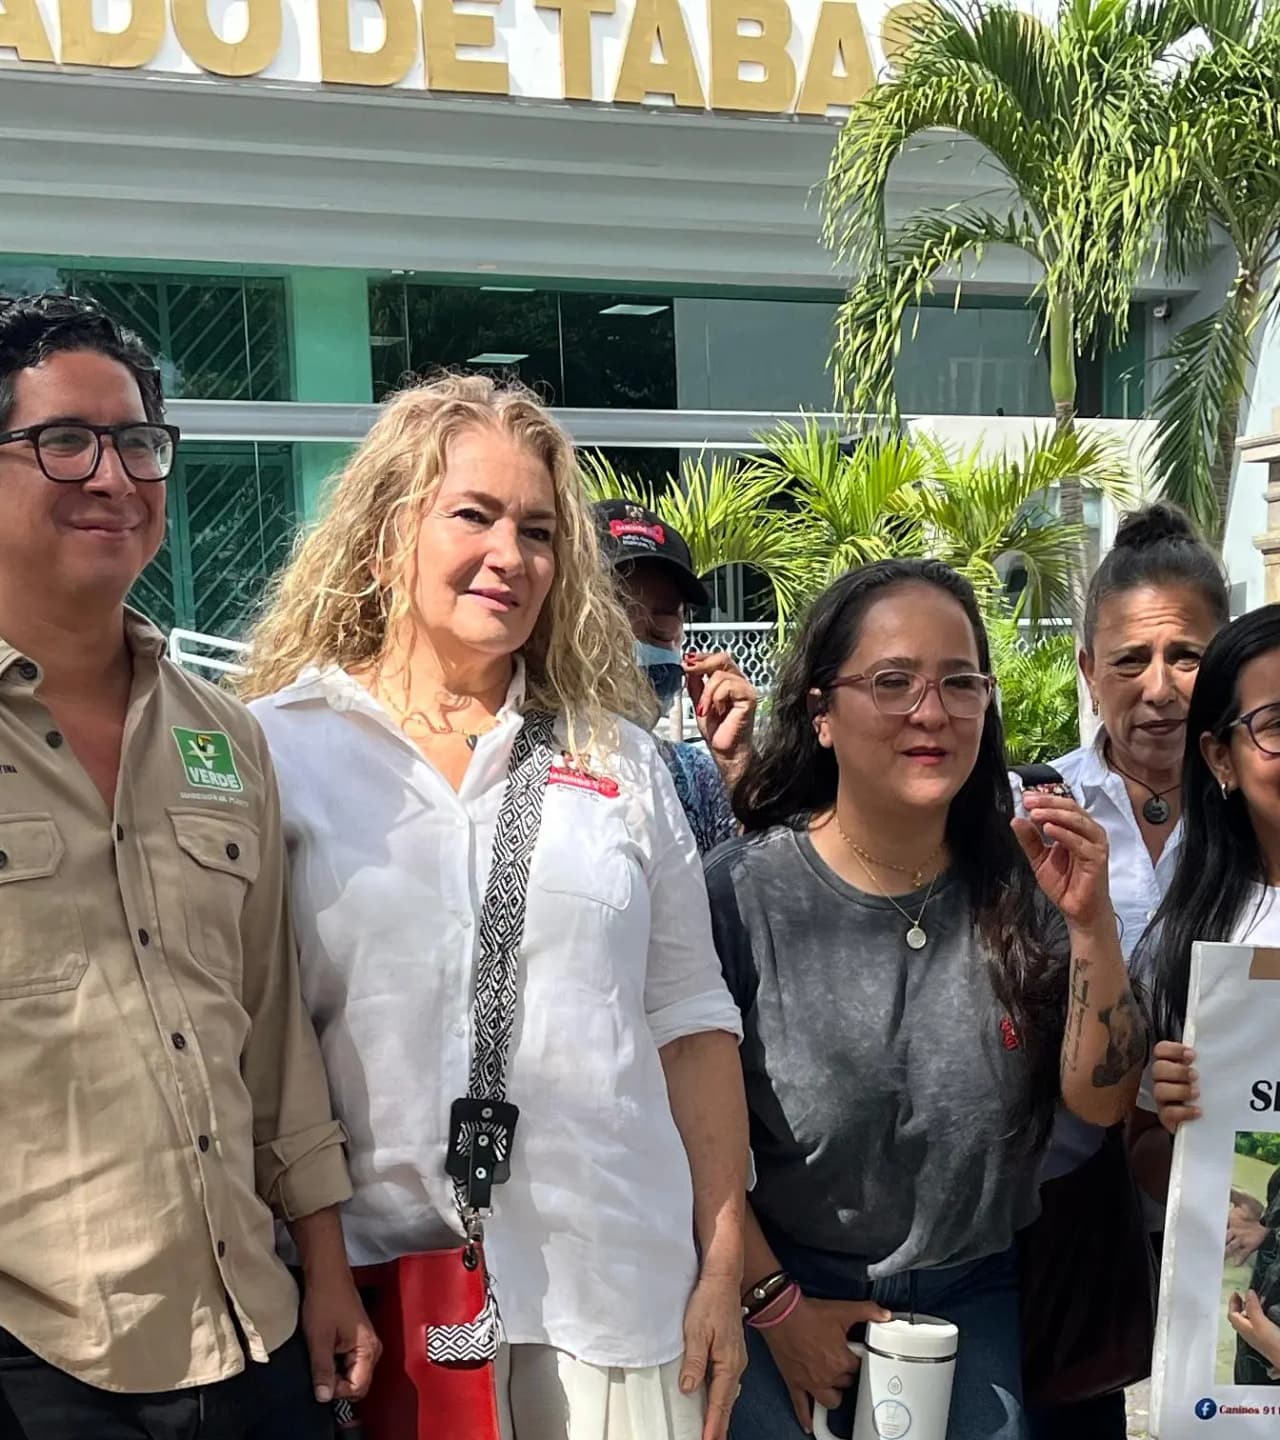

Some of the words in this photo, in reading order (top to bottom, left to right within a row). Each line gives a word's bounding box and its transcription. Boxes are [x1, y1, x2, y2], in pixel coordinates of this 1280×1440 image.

[319, 0, 511, 96] DE
[188, 766, 239, 789] VERDE
[1219, 1404, 1260, 1415] Caninos
